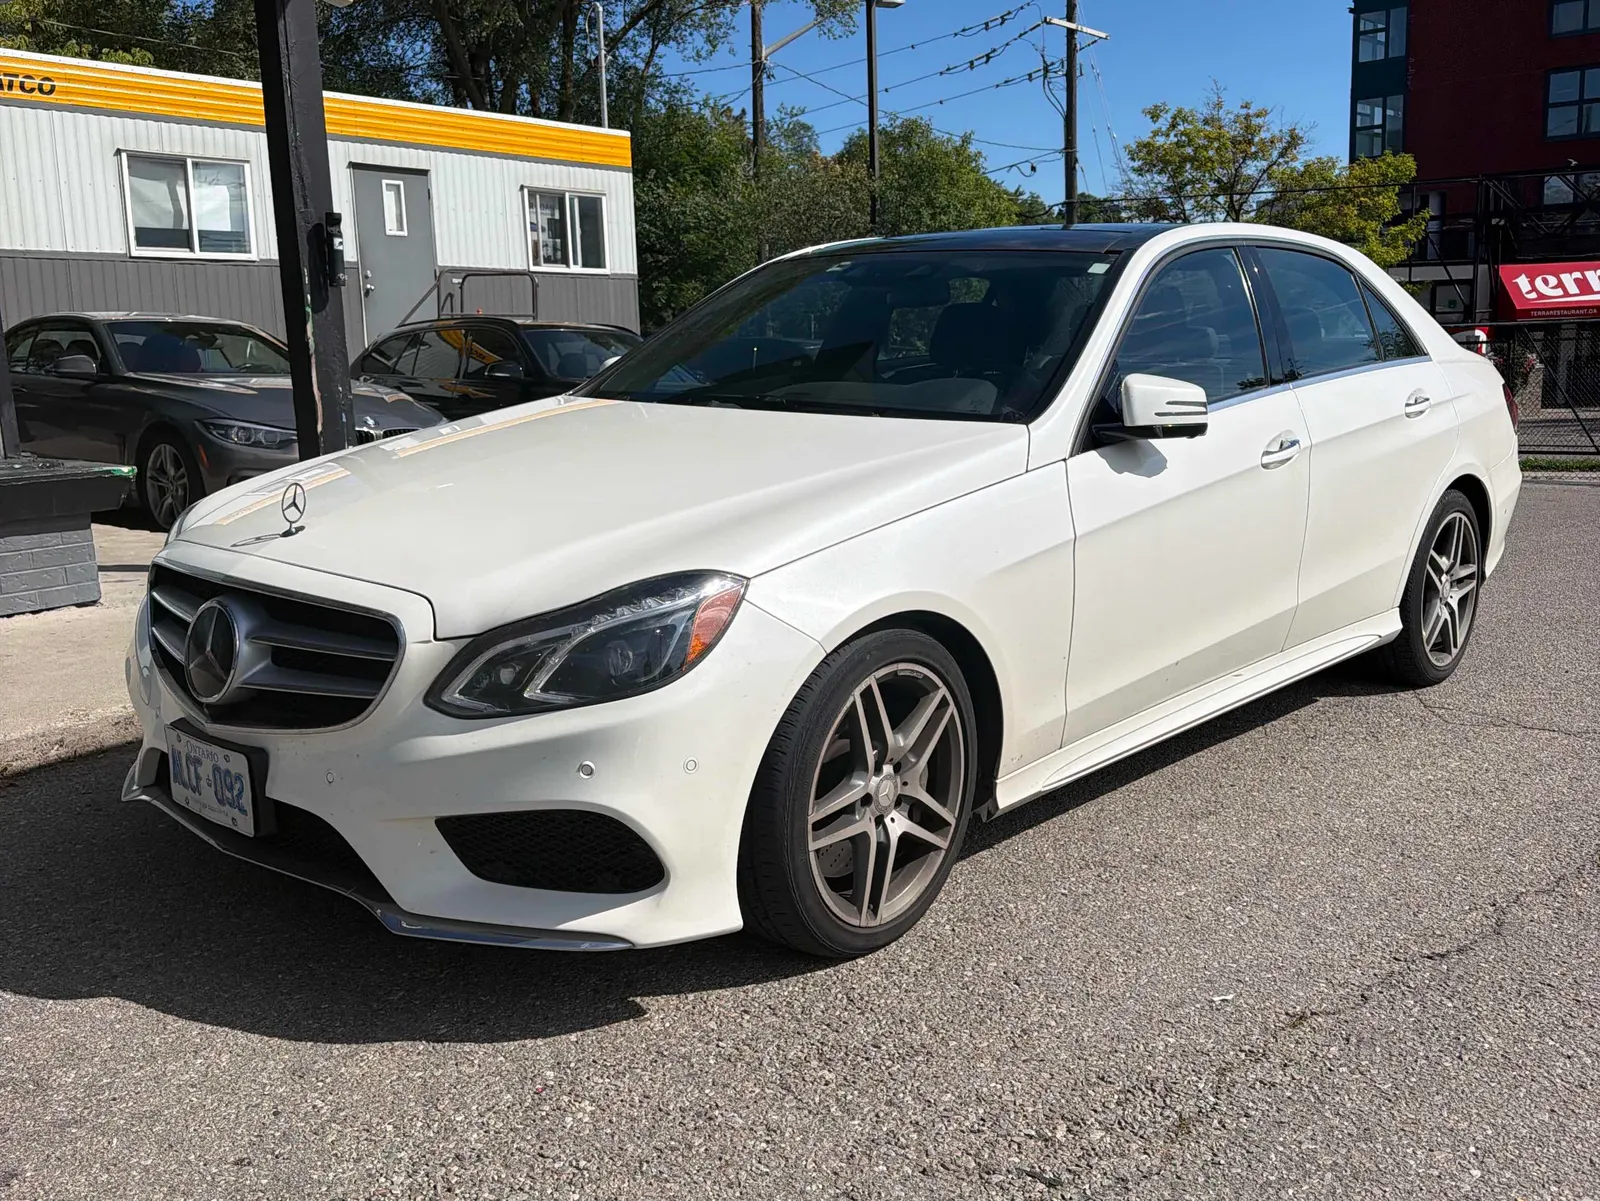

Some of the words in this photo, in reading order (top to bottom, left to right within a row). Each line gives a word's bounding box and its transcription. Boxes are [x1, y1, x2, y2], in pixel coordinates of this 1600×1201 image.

[0, 73, 56, 95] TCO
[1530, 308, 1597, 316] TERRARESTAURANT.CA
[186, 741, 219, 762] ONTARIO
[212, 764, 248, 816] 092
